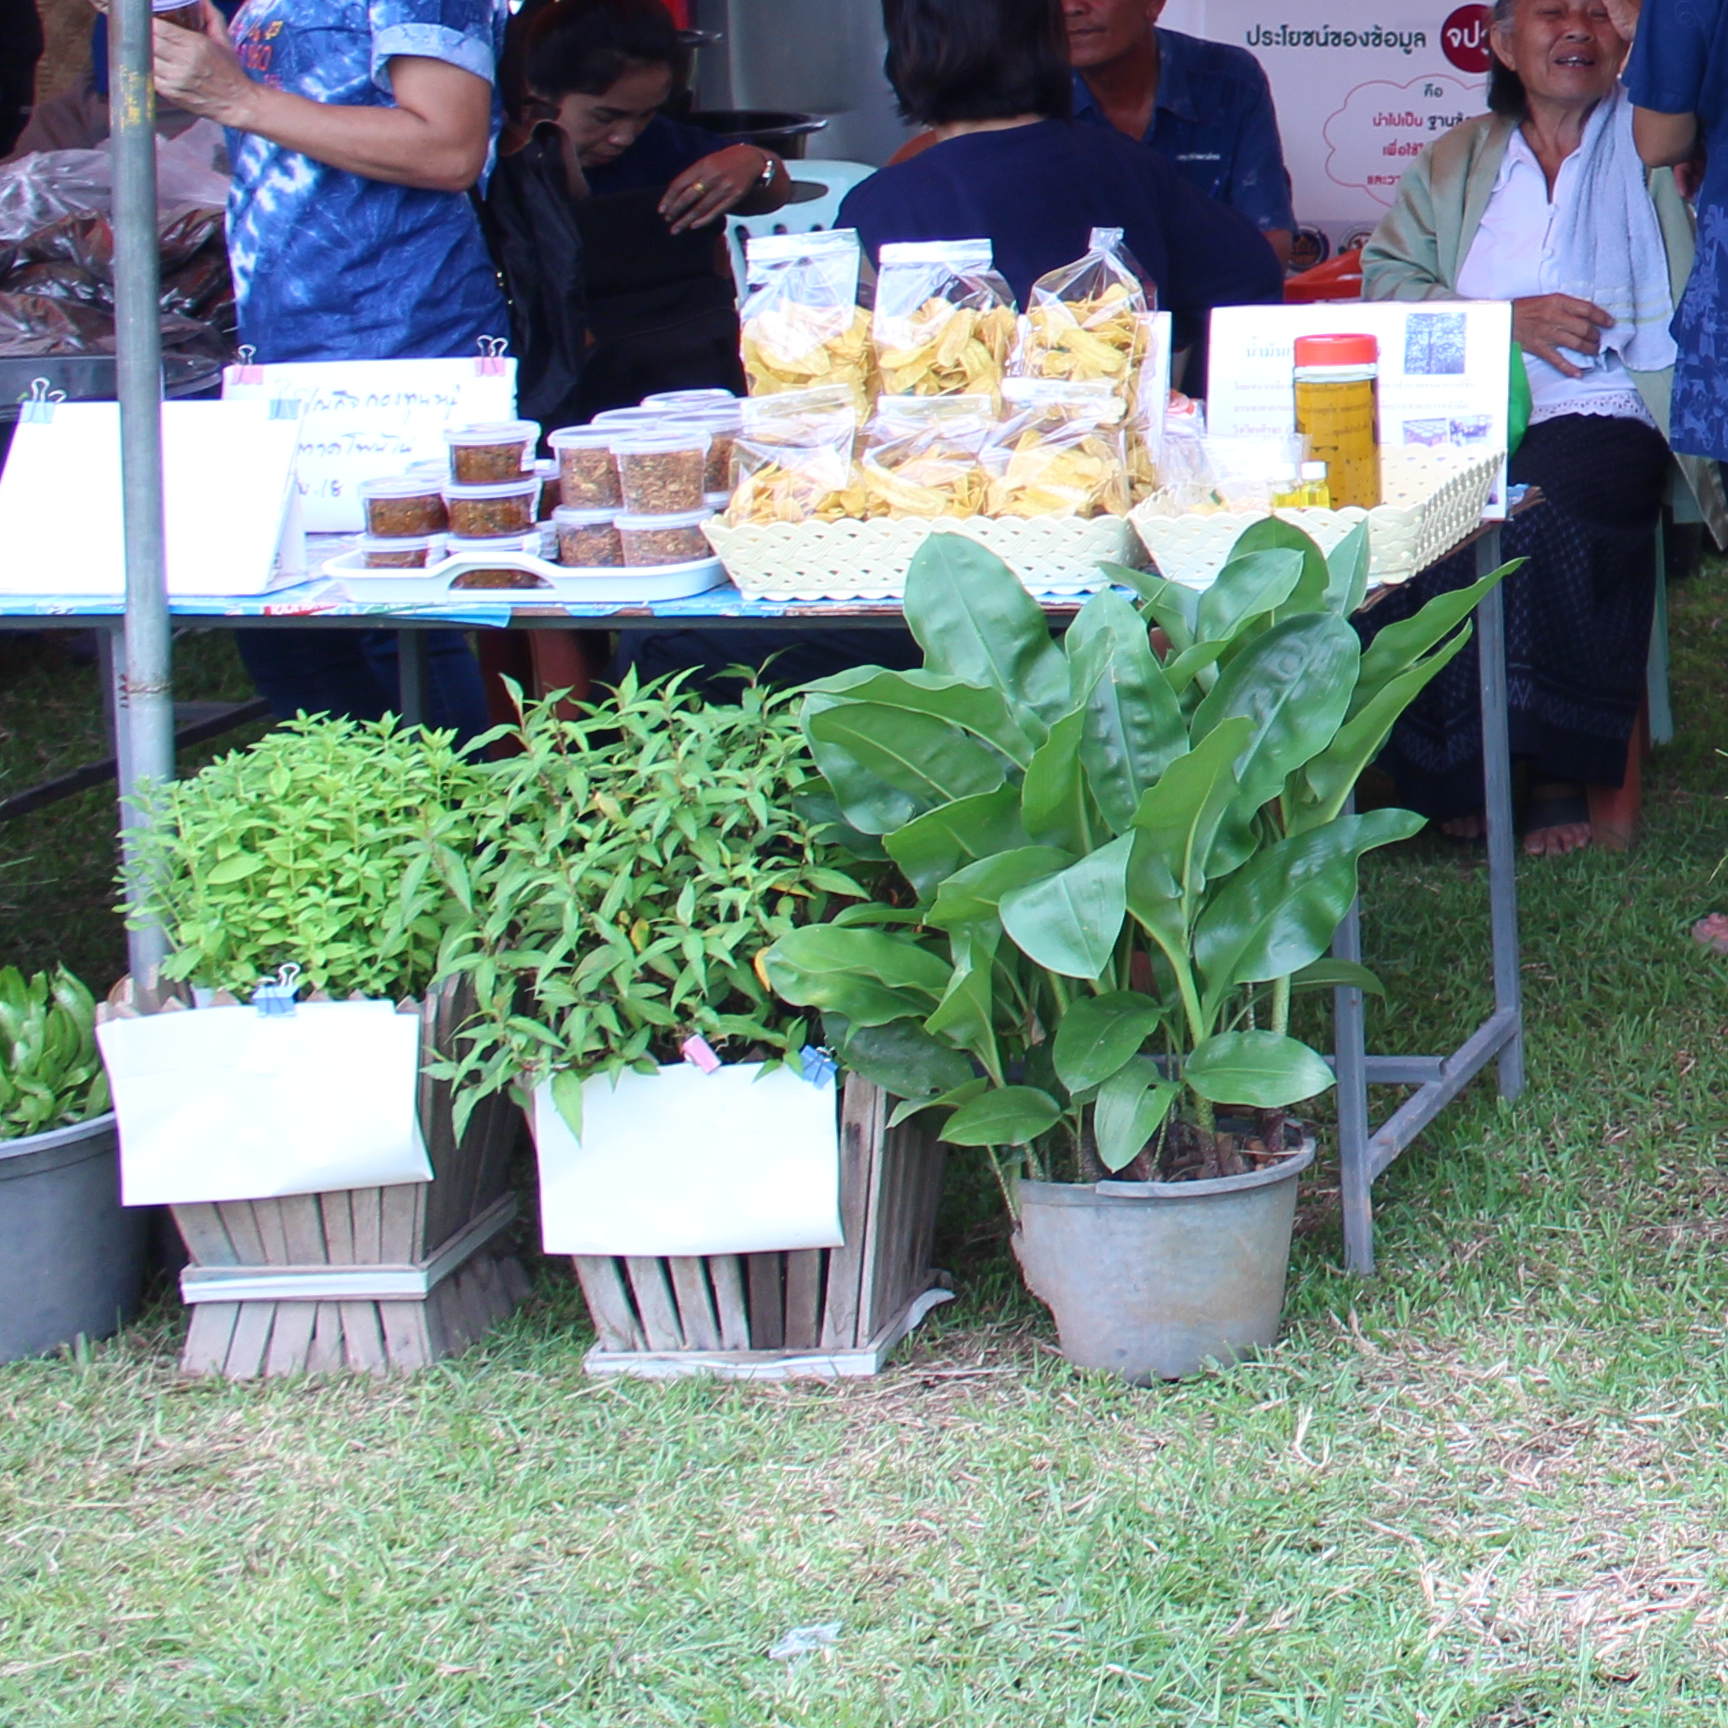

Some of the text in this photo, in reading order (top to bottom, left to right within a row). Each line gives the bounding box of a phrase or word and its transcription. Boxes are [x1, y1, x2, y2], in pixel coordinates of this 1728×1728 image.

[1246, 19, 1427, 56] ประโยชน์ของข้อมูล
[1424, 83, 1444, 98] คือ
[1372, 112, 1424, 128] นำไปเป็น
